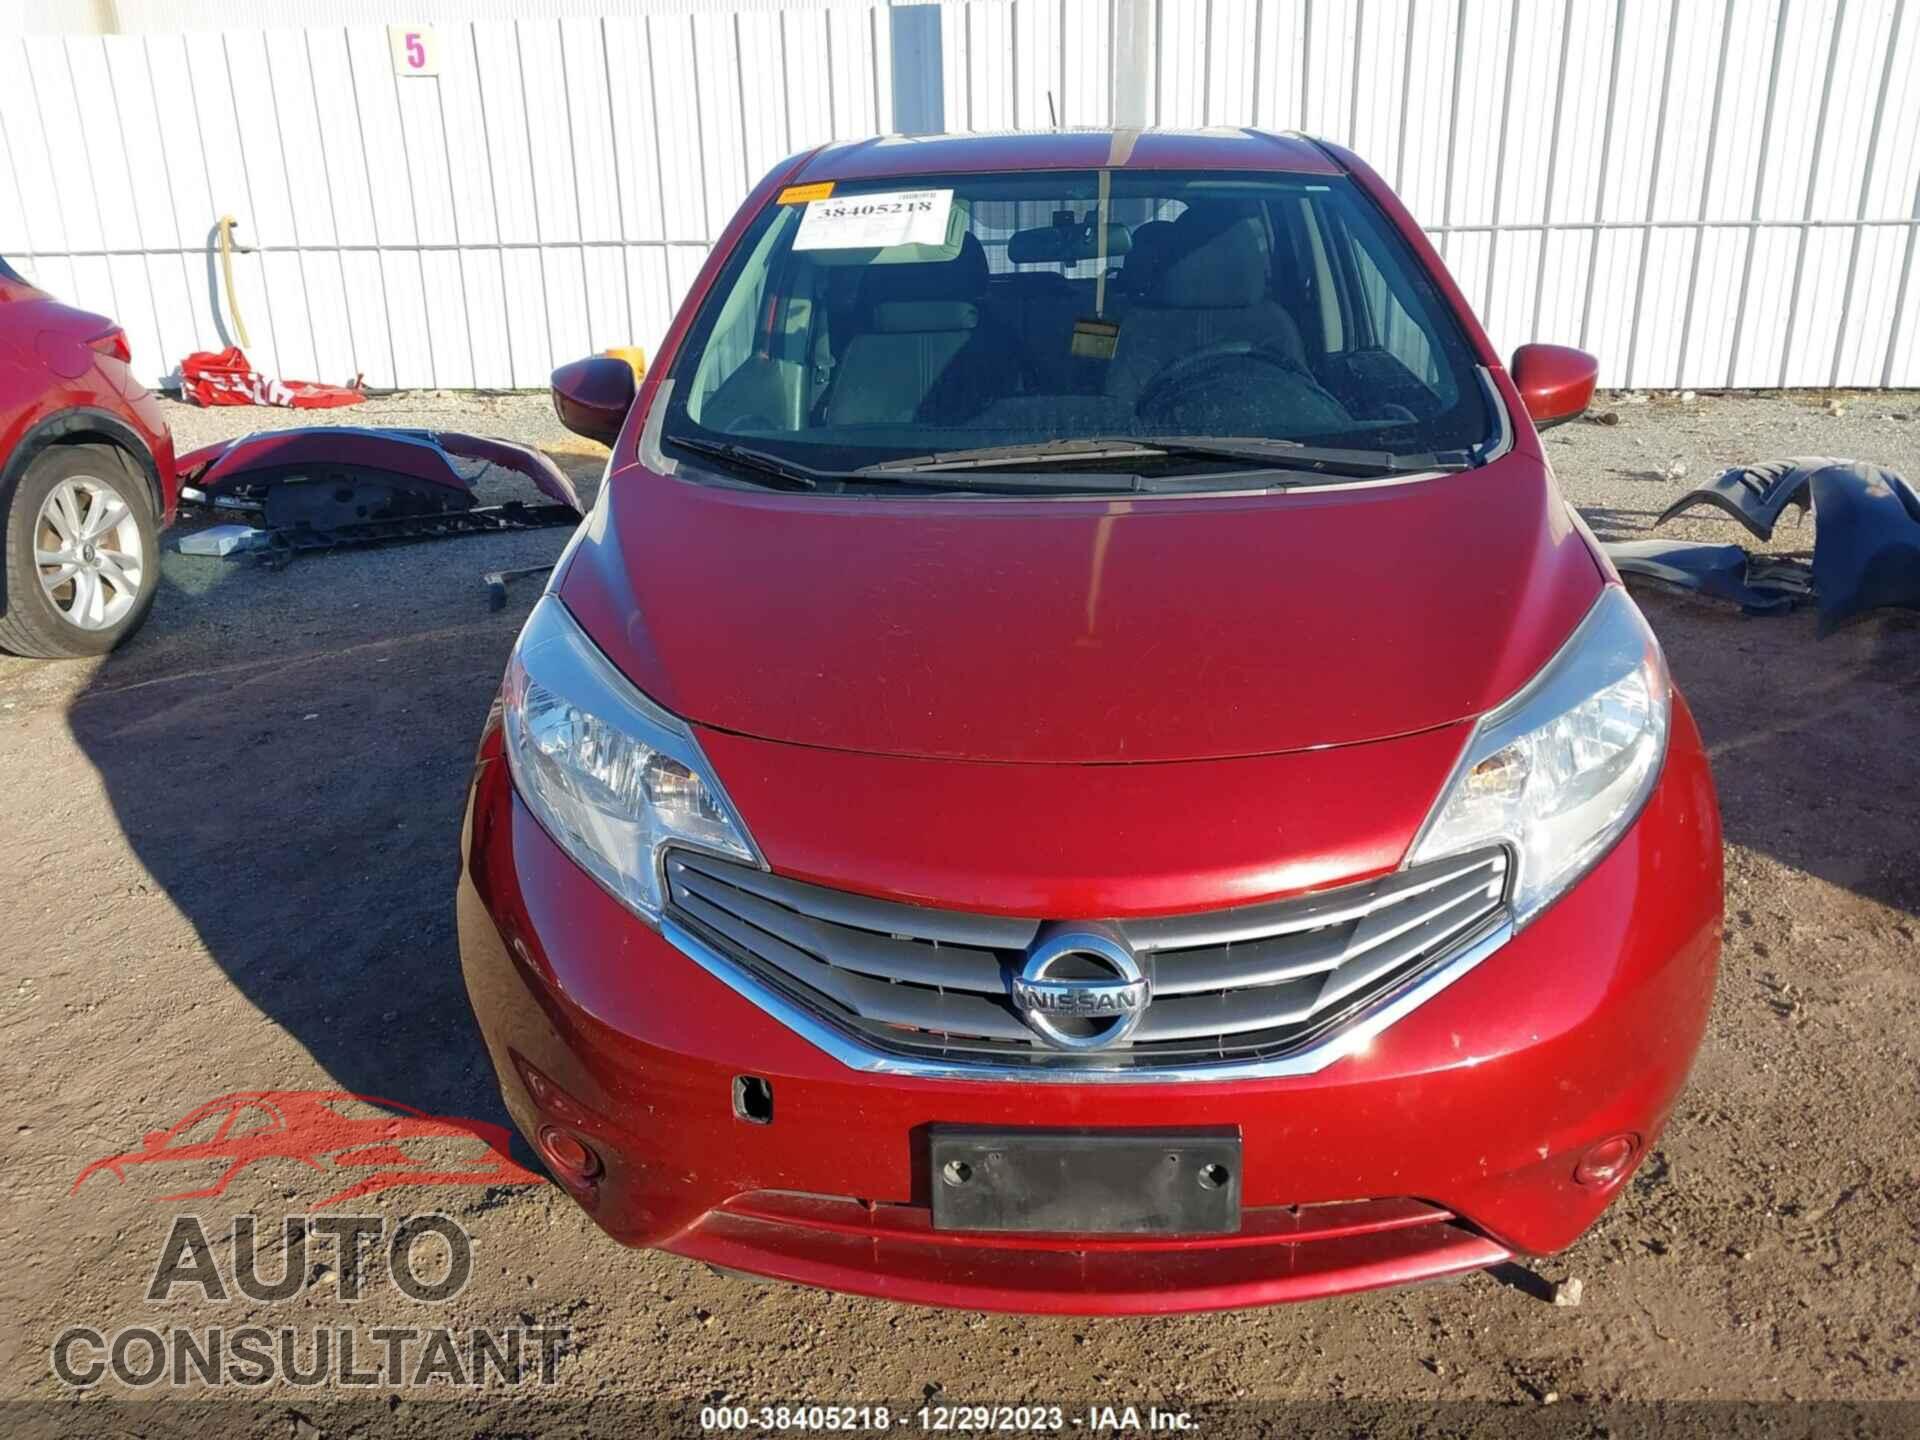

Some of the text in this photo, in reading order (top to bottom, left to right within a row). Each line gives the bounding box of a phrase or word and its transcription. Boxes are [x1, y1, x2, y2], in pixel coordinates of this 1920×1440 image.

[405, 33, 425, 68] 5
[818, 201, 932, 218] 38405218
[1026, 990, 1136, 1010] NISSAN
